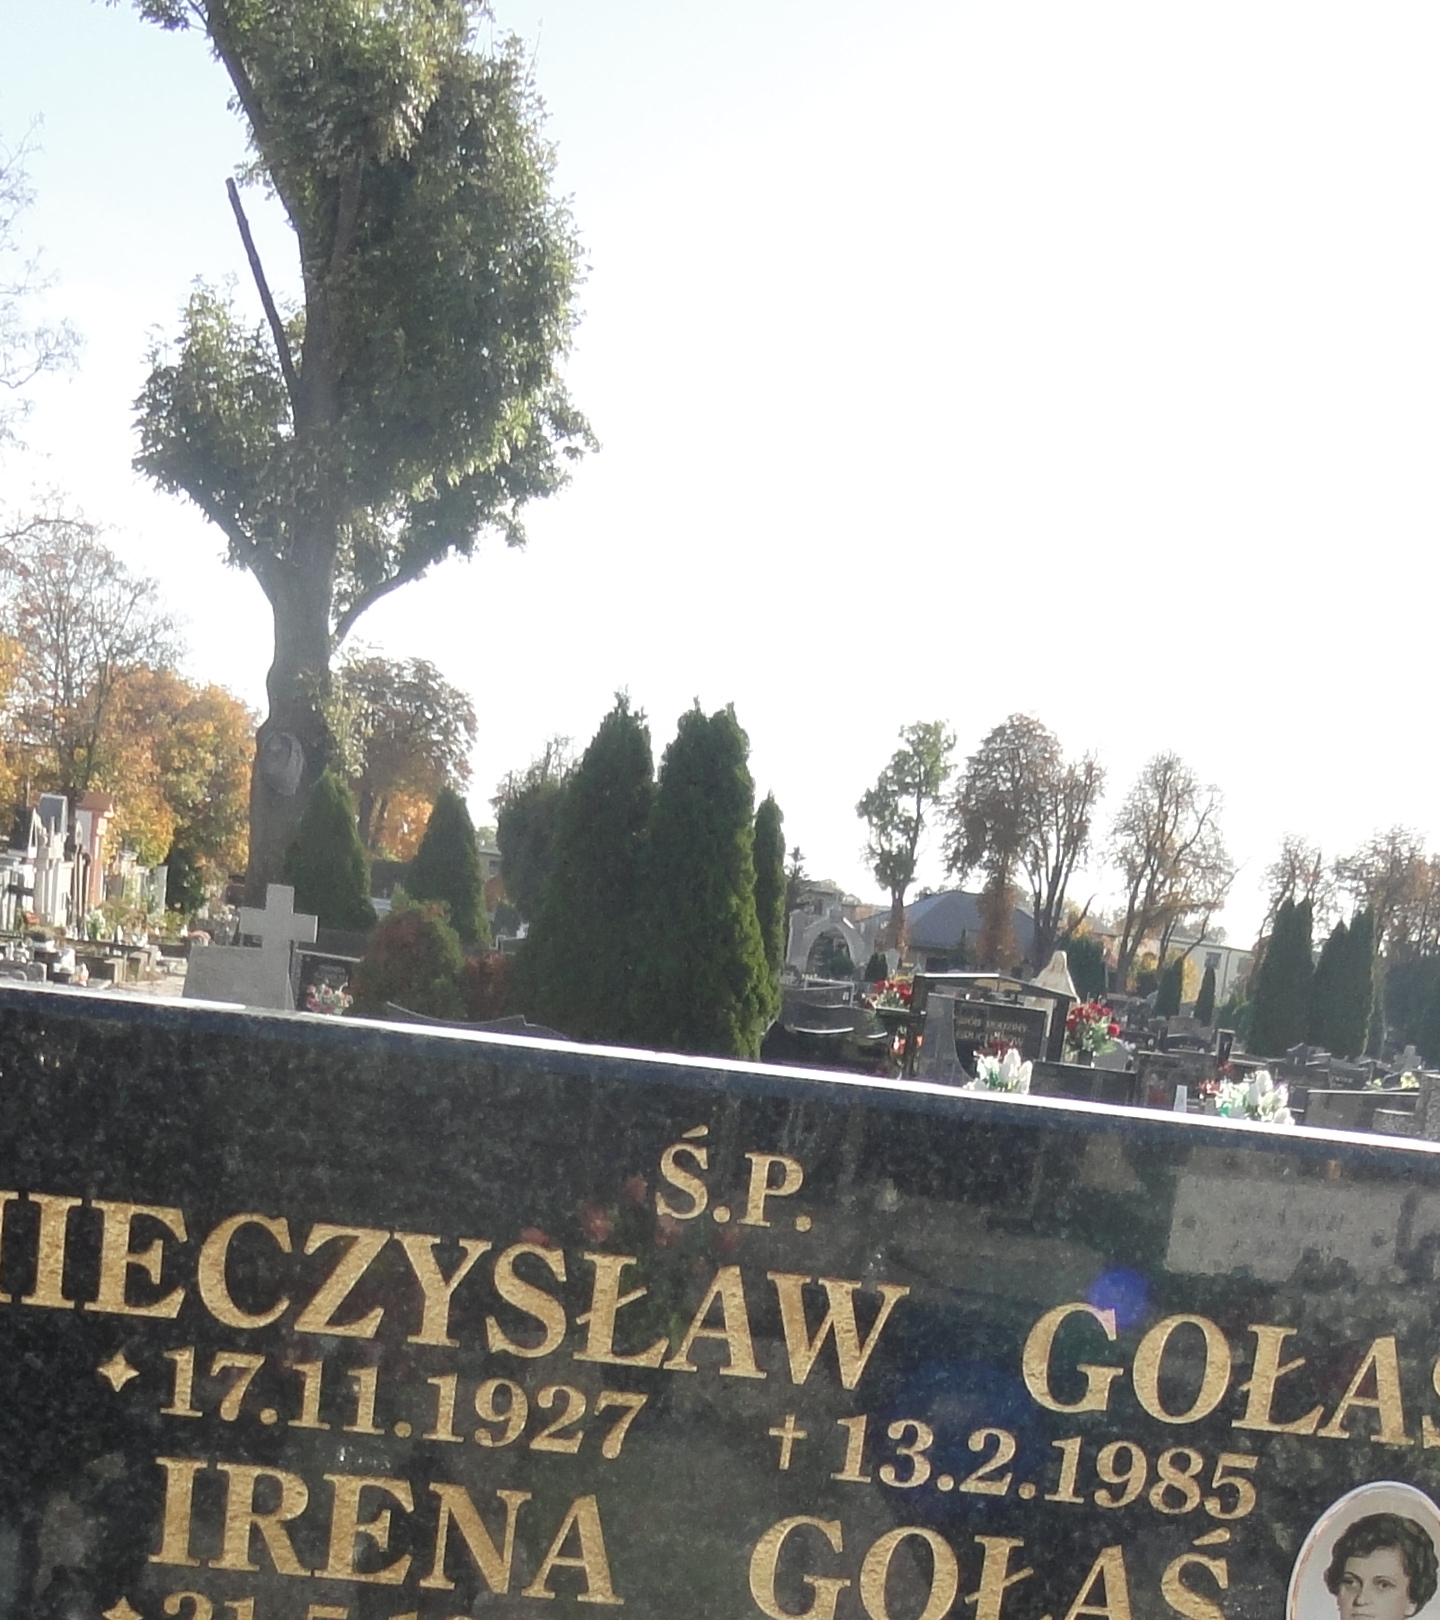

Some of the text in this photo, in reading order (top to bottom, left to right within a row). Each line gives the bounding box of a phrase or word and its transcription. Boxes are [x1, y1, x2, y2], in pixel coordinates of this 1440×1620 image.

[654, 1125, 813, 1233] Ś.P.
[160, 1346, 1260, 1520] 17.11.1927 13.2.1985
[147, 1456, 625, 1606] IRENA
